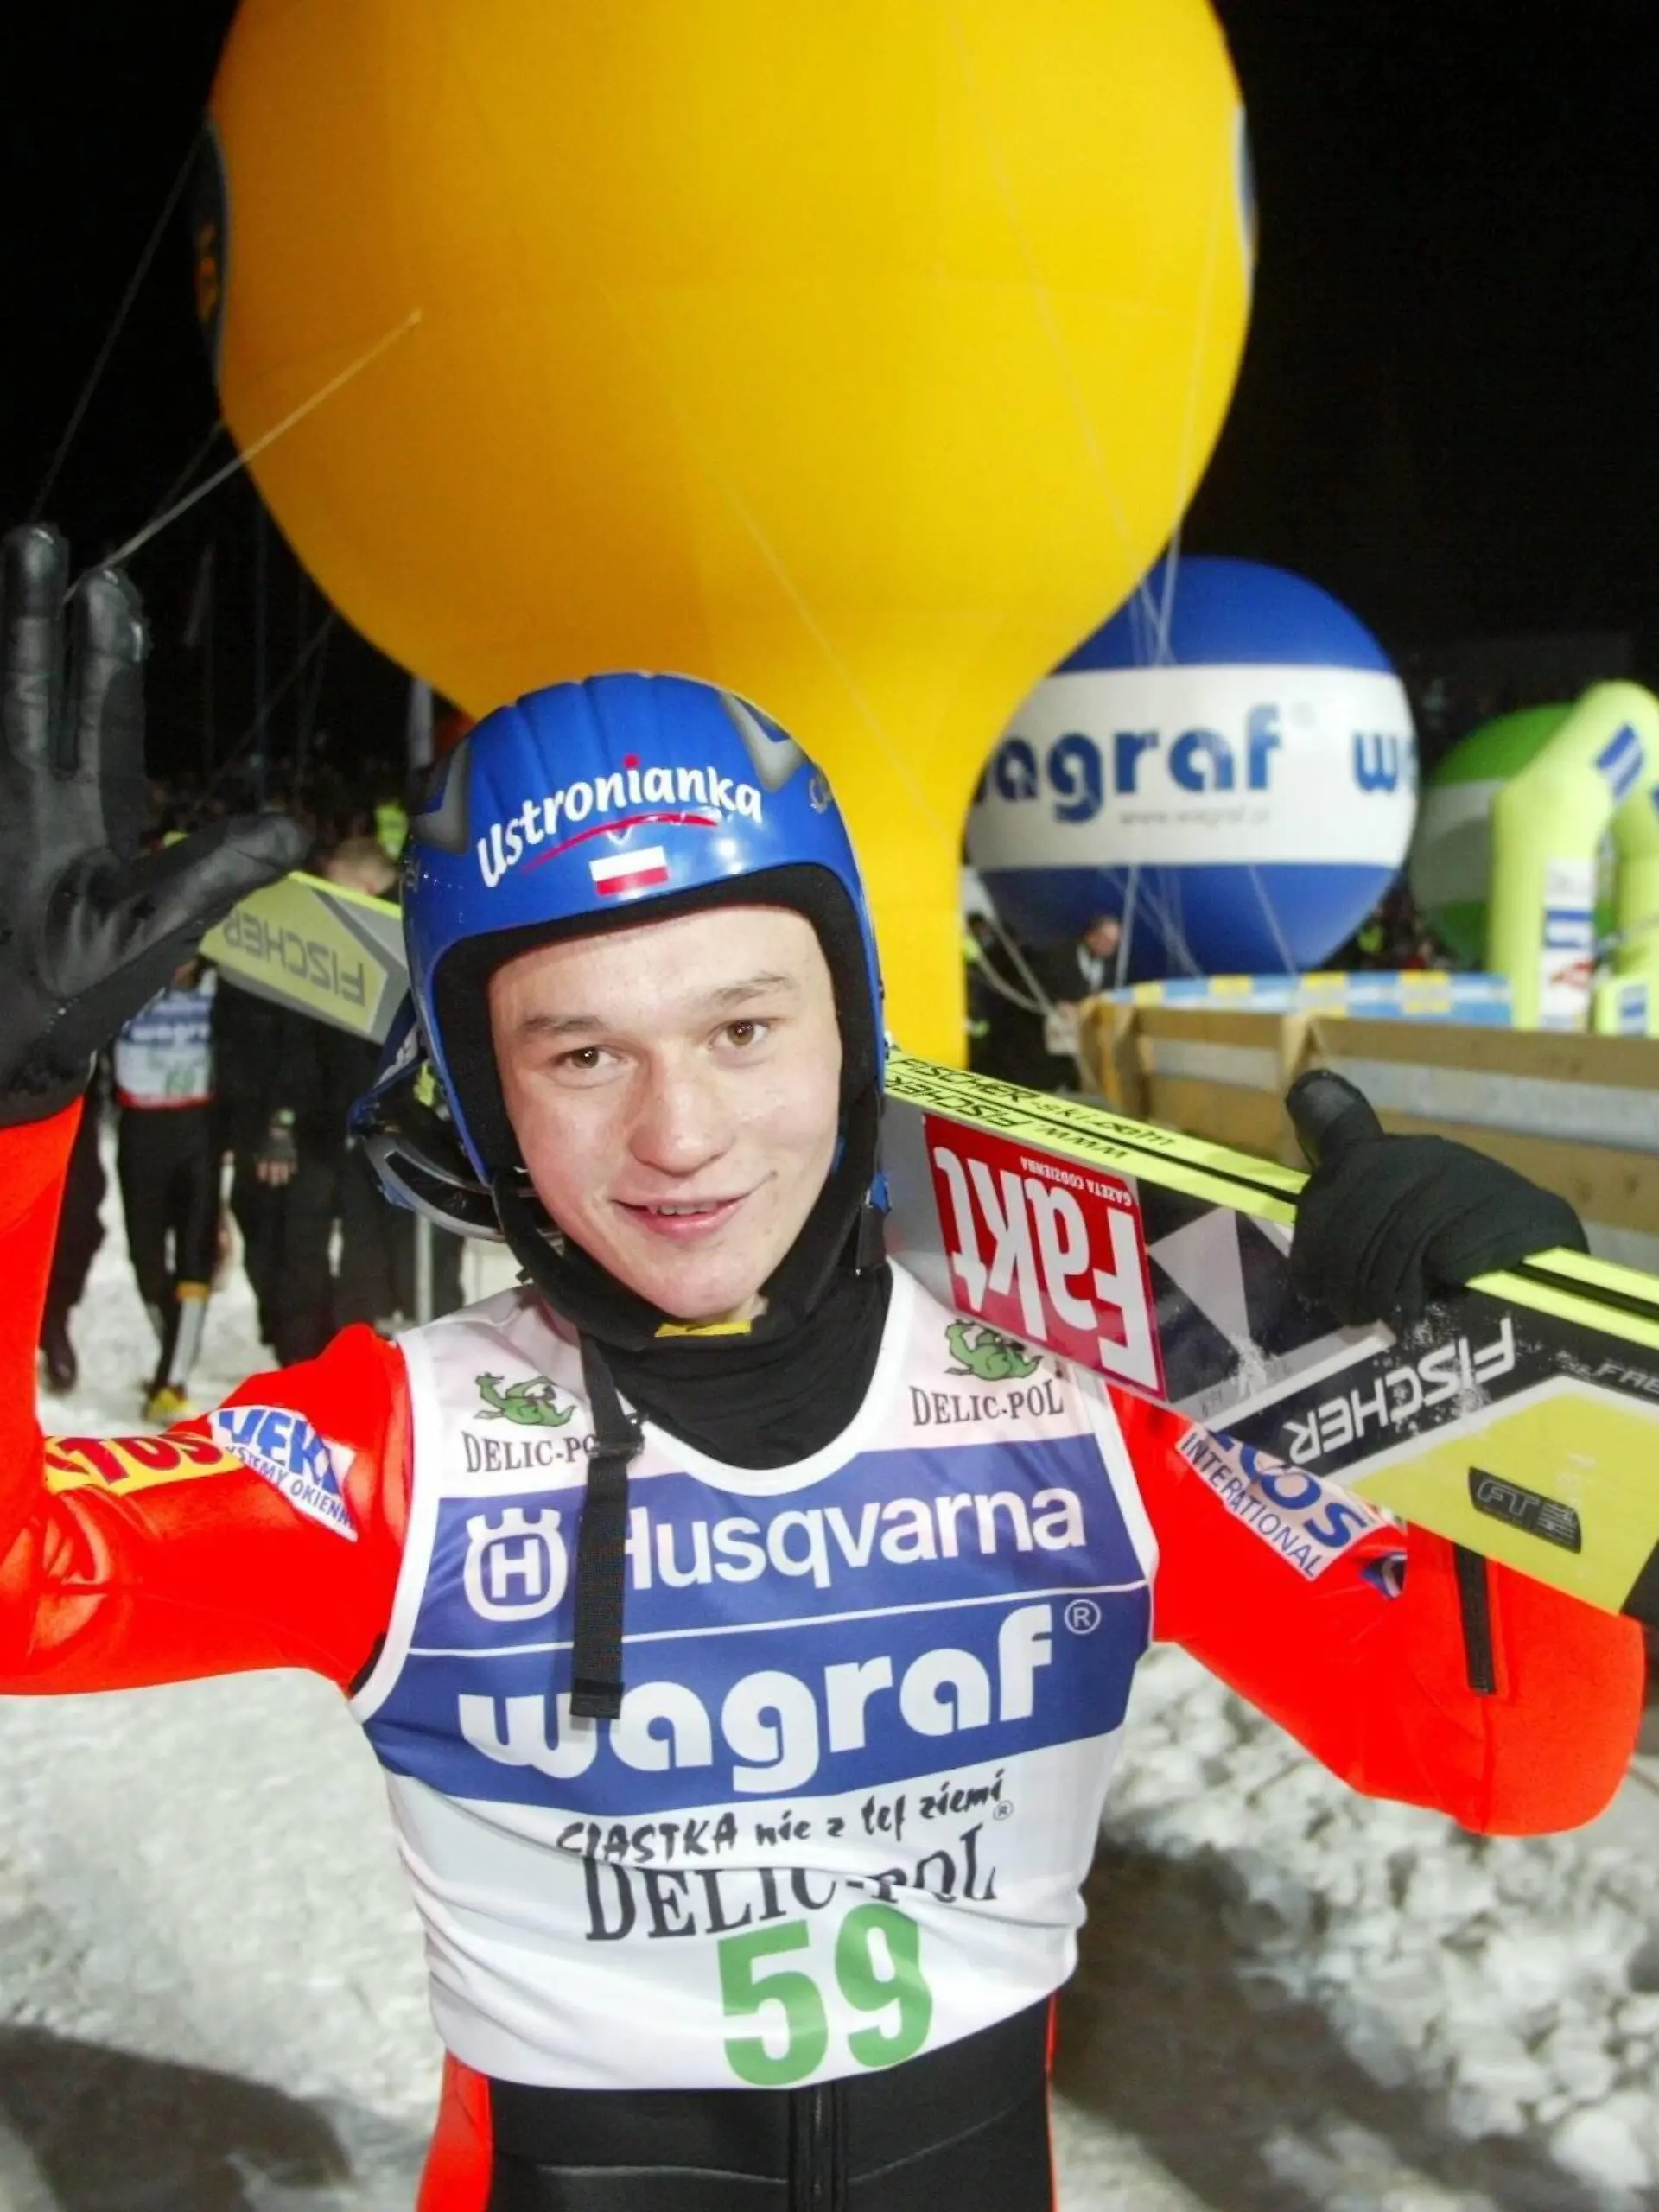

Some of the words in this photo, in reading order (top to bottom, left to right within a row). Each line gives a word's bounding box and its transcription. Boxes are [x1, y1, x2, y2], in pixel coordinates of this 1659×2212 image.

[477, 753, 763, 888] Ustronianka
[975, 703, 1282, 823] agraf
[223, 909, 366, 1007] FISCHER
[935, 1146, 1159, 1392] Fakt
[461, 1430, 598, 1473] DELIC-PO
[909, 1378, 1065, 1427] DELIC-POL
[1284, 1316, 1516, 1465] FISCHER
[290, 1478, 358, 1529] OKIENN
[1180, 1432, 1323, 1578] INTERNATIONAL
[458, 1604, 1052, 1793] wagraf
[556, 1812, 738, 1863] CIASTKA
[755, 1809, 811, 1845] nie
[827, 1817, 846, 1837] z
[919, 1768, 1006, 1819] ziemi
[716, 1903, 933, 2087] 59
